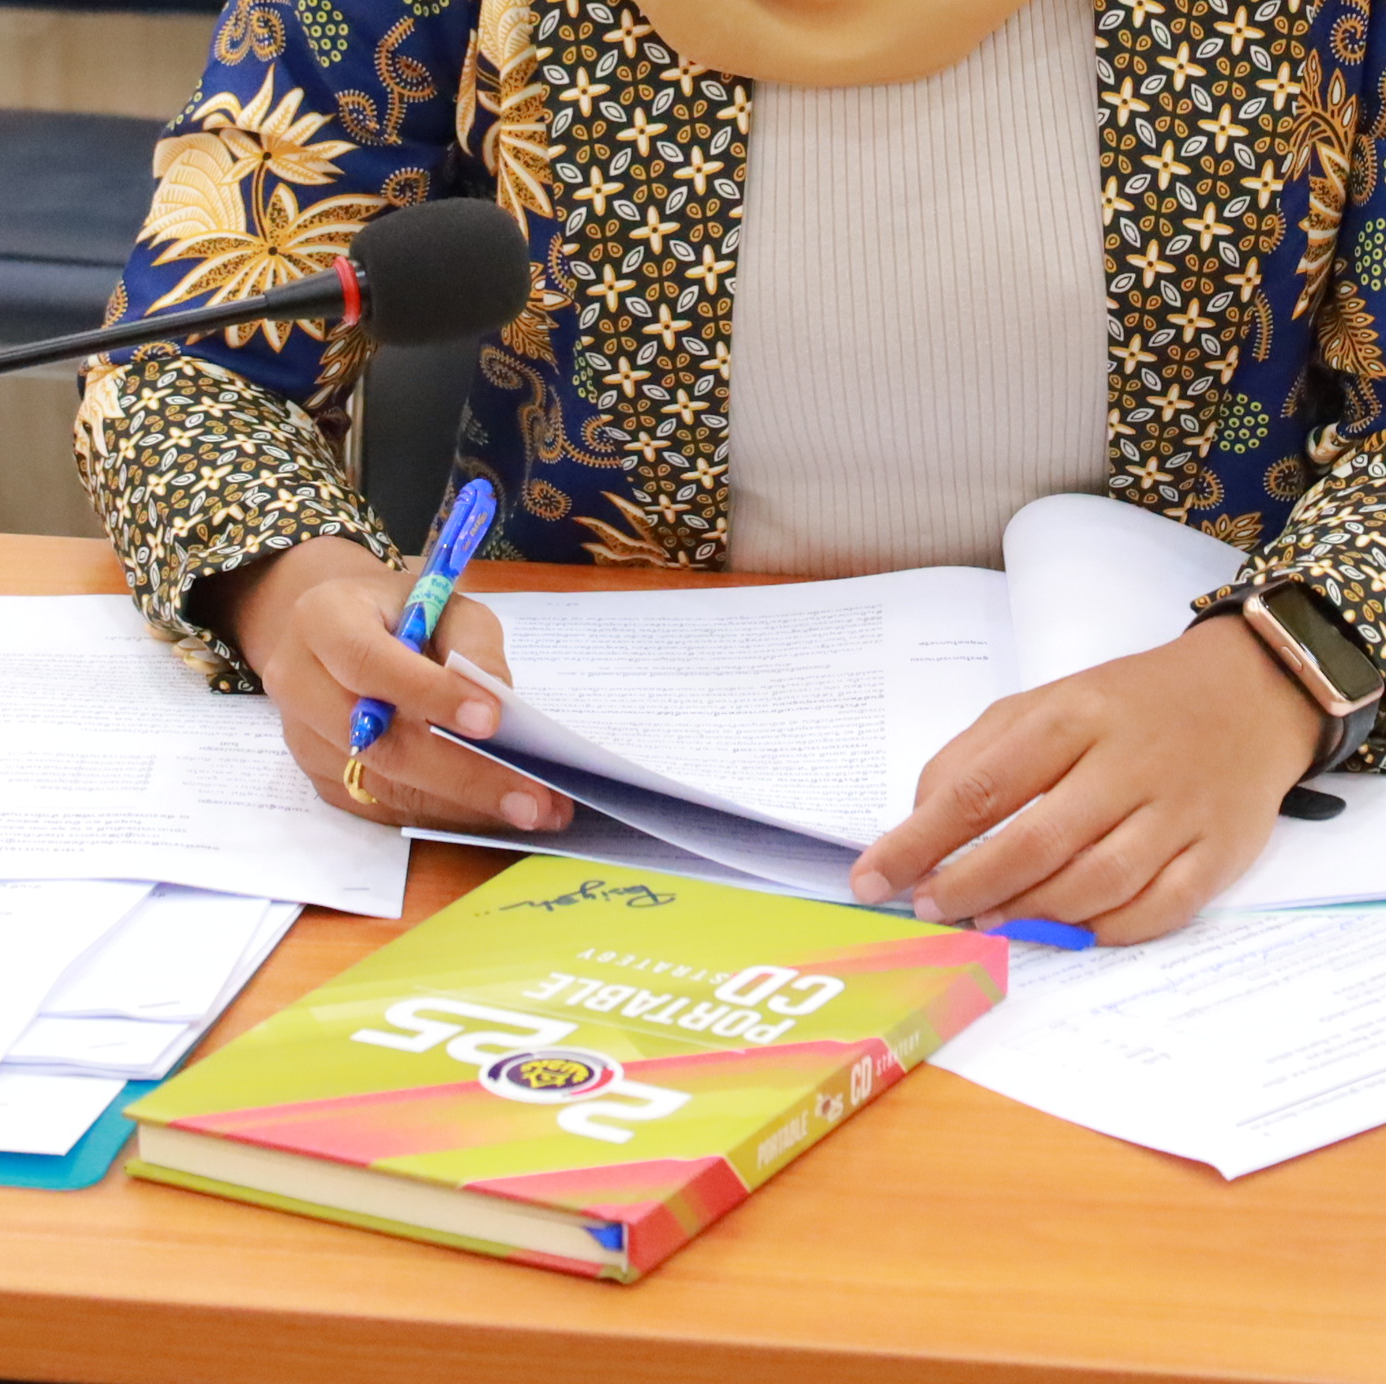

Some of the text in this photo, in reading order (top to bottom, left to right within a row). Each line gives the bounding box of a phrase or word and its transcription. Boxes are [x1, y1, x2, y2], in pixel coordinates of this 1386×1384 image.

[522, 971, 797, 1045] PORTABLE
[577, 947, 845, 1016] CD STRATEGY
[850, 1054, 873, 1106] CD
